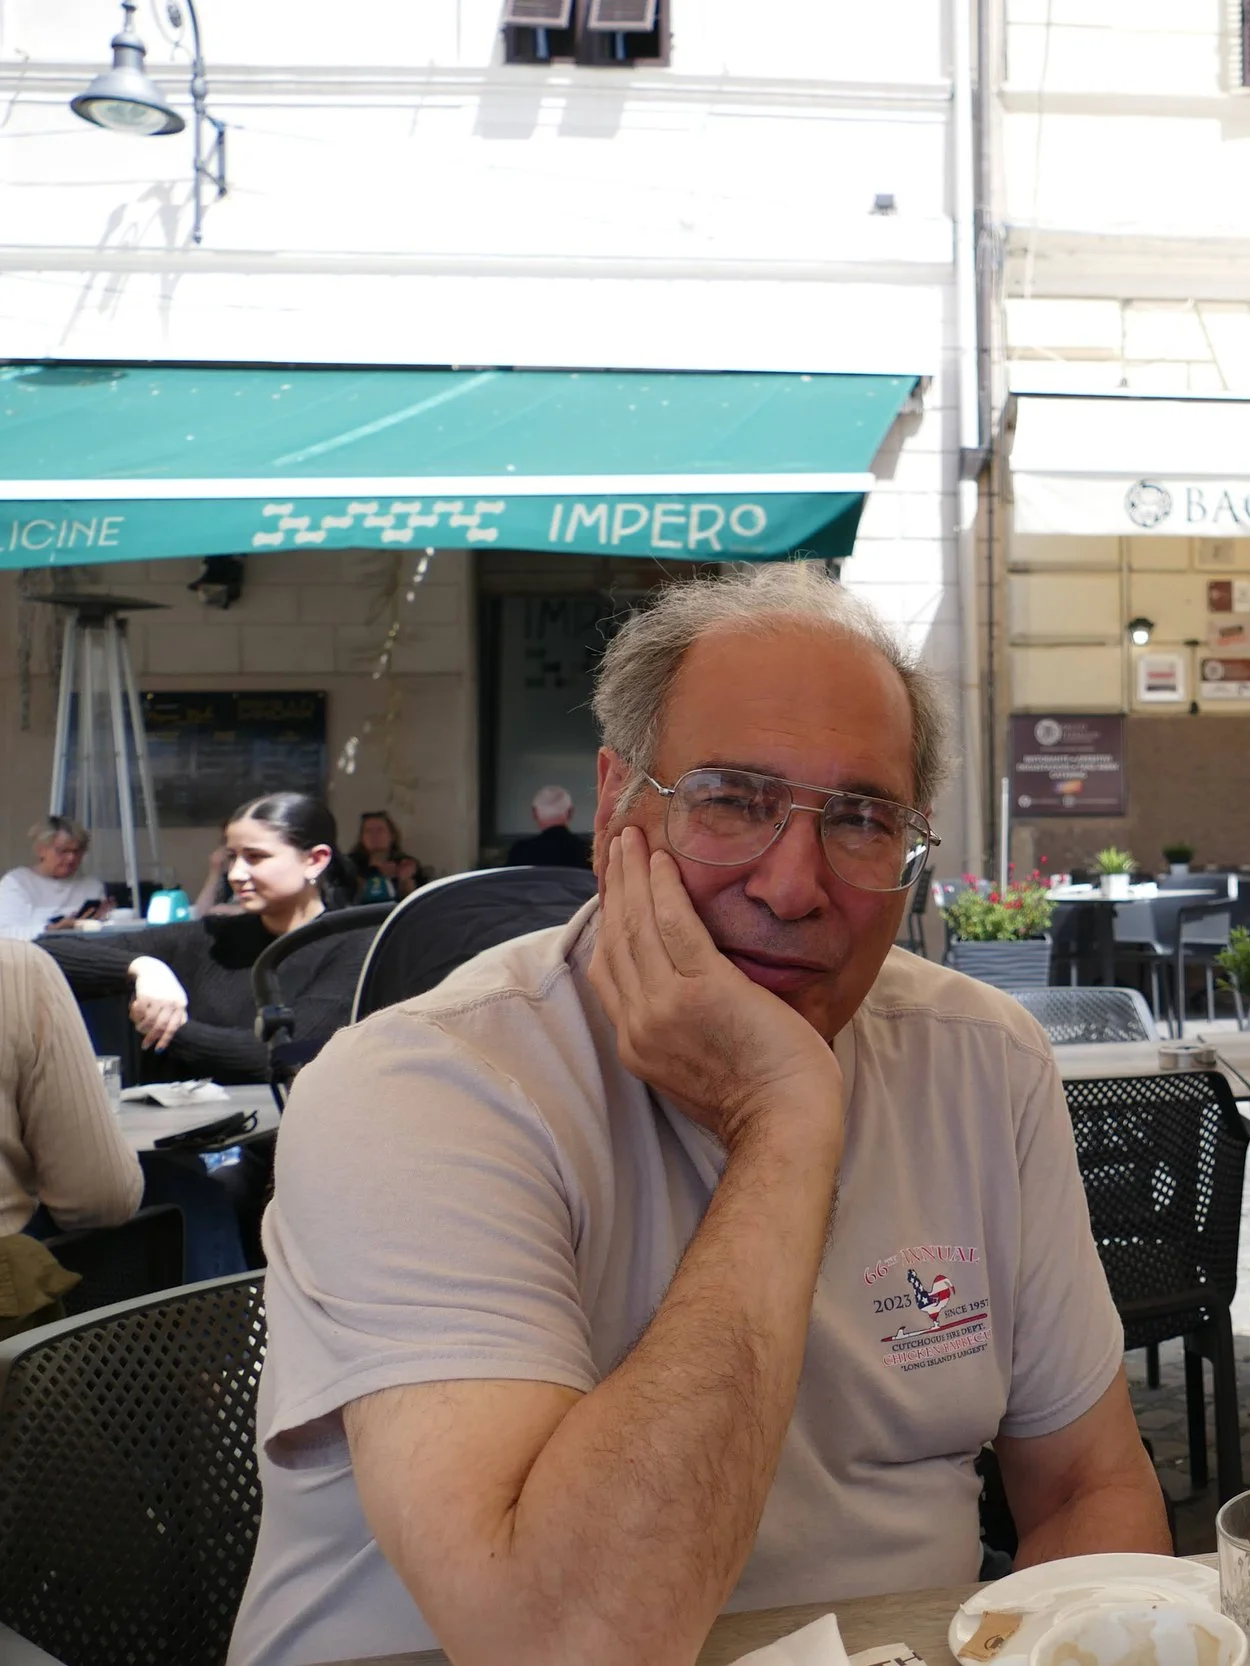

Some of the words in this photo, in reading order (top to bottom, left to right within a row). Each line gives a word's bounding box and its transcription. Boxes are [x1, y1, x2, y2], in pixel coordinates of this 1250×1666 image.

[0, 516, 125, 553] ICINE
[548, 502, 768, 551] IMPERO
[900, 1245, 981, 1267] ANNUAL
[873, 1293, 912, 1314] 2023
[944, 1305, 968, 1319] SINCE
[881, 1344, 943, 1368] CHICKEN
[943, 1328, 993, 1353] BARBECU
[892, 1335, 945, 1352] CUTCHOGUE
[946, 1330, 961, 1341] FIRE
[961, 1323, 986, 1336] DEPT.
